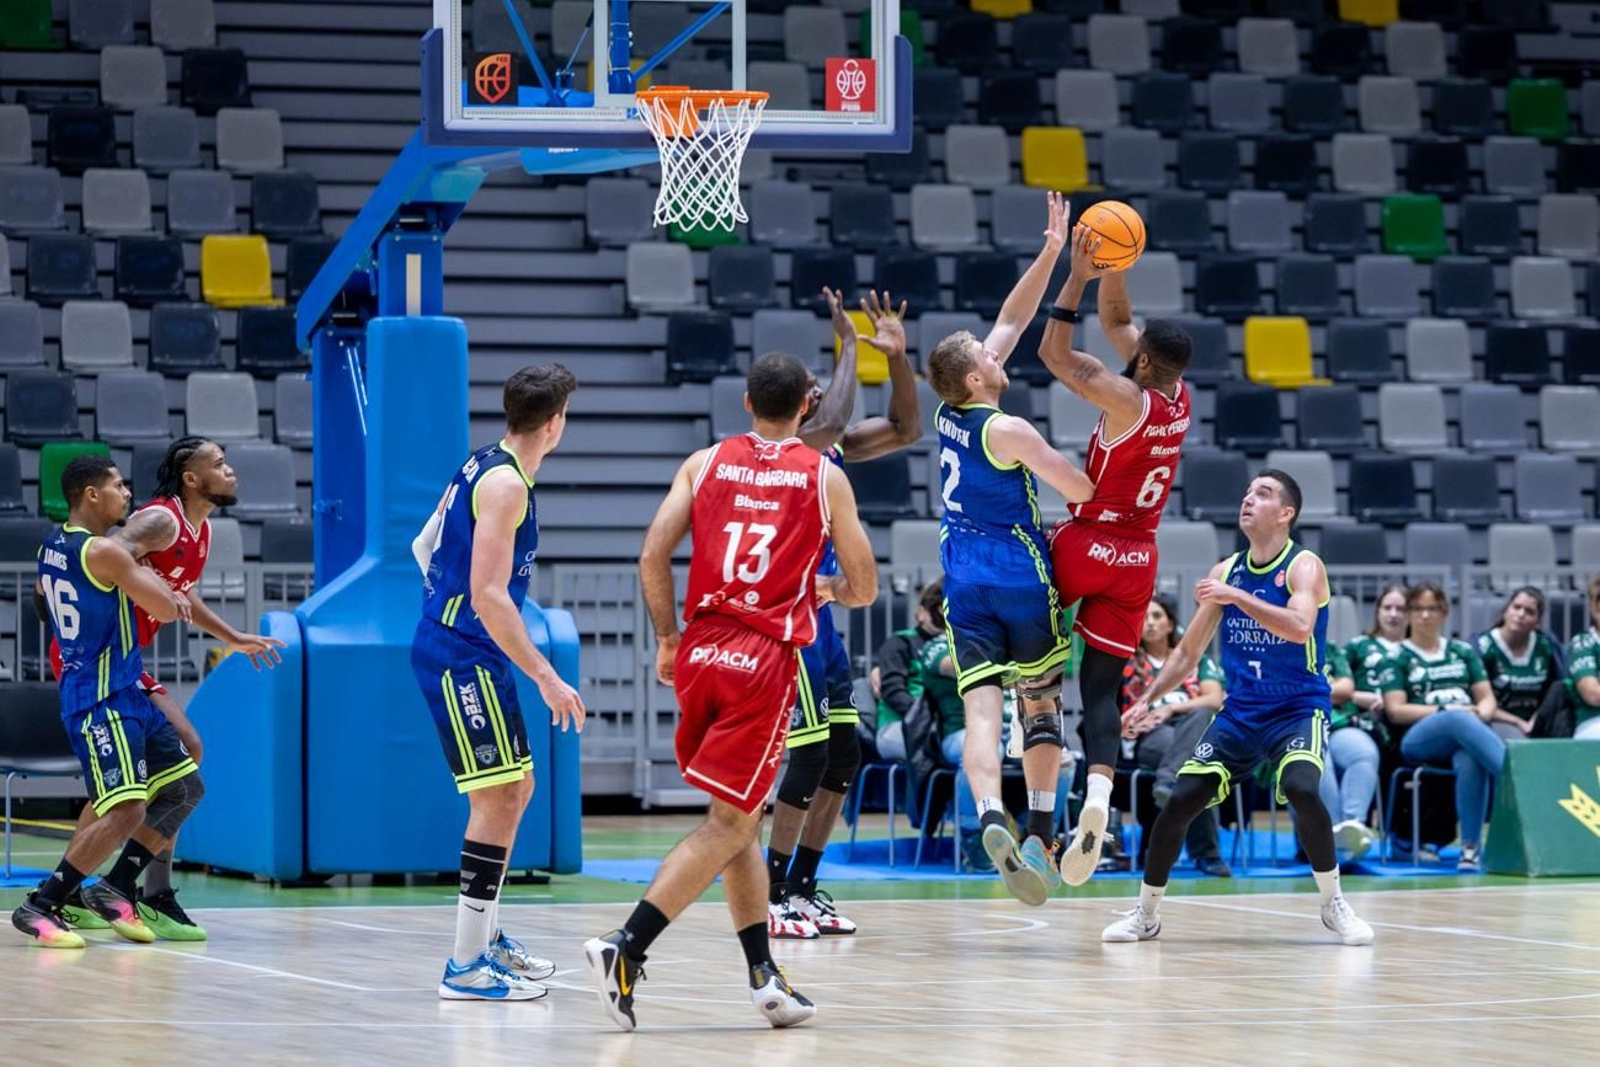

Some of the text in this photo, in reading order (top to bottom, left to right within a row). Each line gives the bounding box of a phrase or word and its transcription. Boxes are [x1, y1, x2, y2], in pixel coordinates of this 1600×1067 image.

[716, 463, 754, 485] SANTA
[940, 446, 963, 514] 2
[1135, 465, 1171, 509] 6
[734, 494, 779, 510] Blanca
[722, 521, 778, 584] 13
[1116, 551, 1150, 564] ACM
[41, 574, 80, 640] 16
[716, 649, 759, 671] ACM
